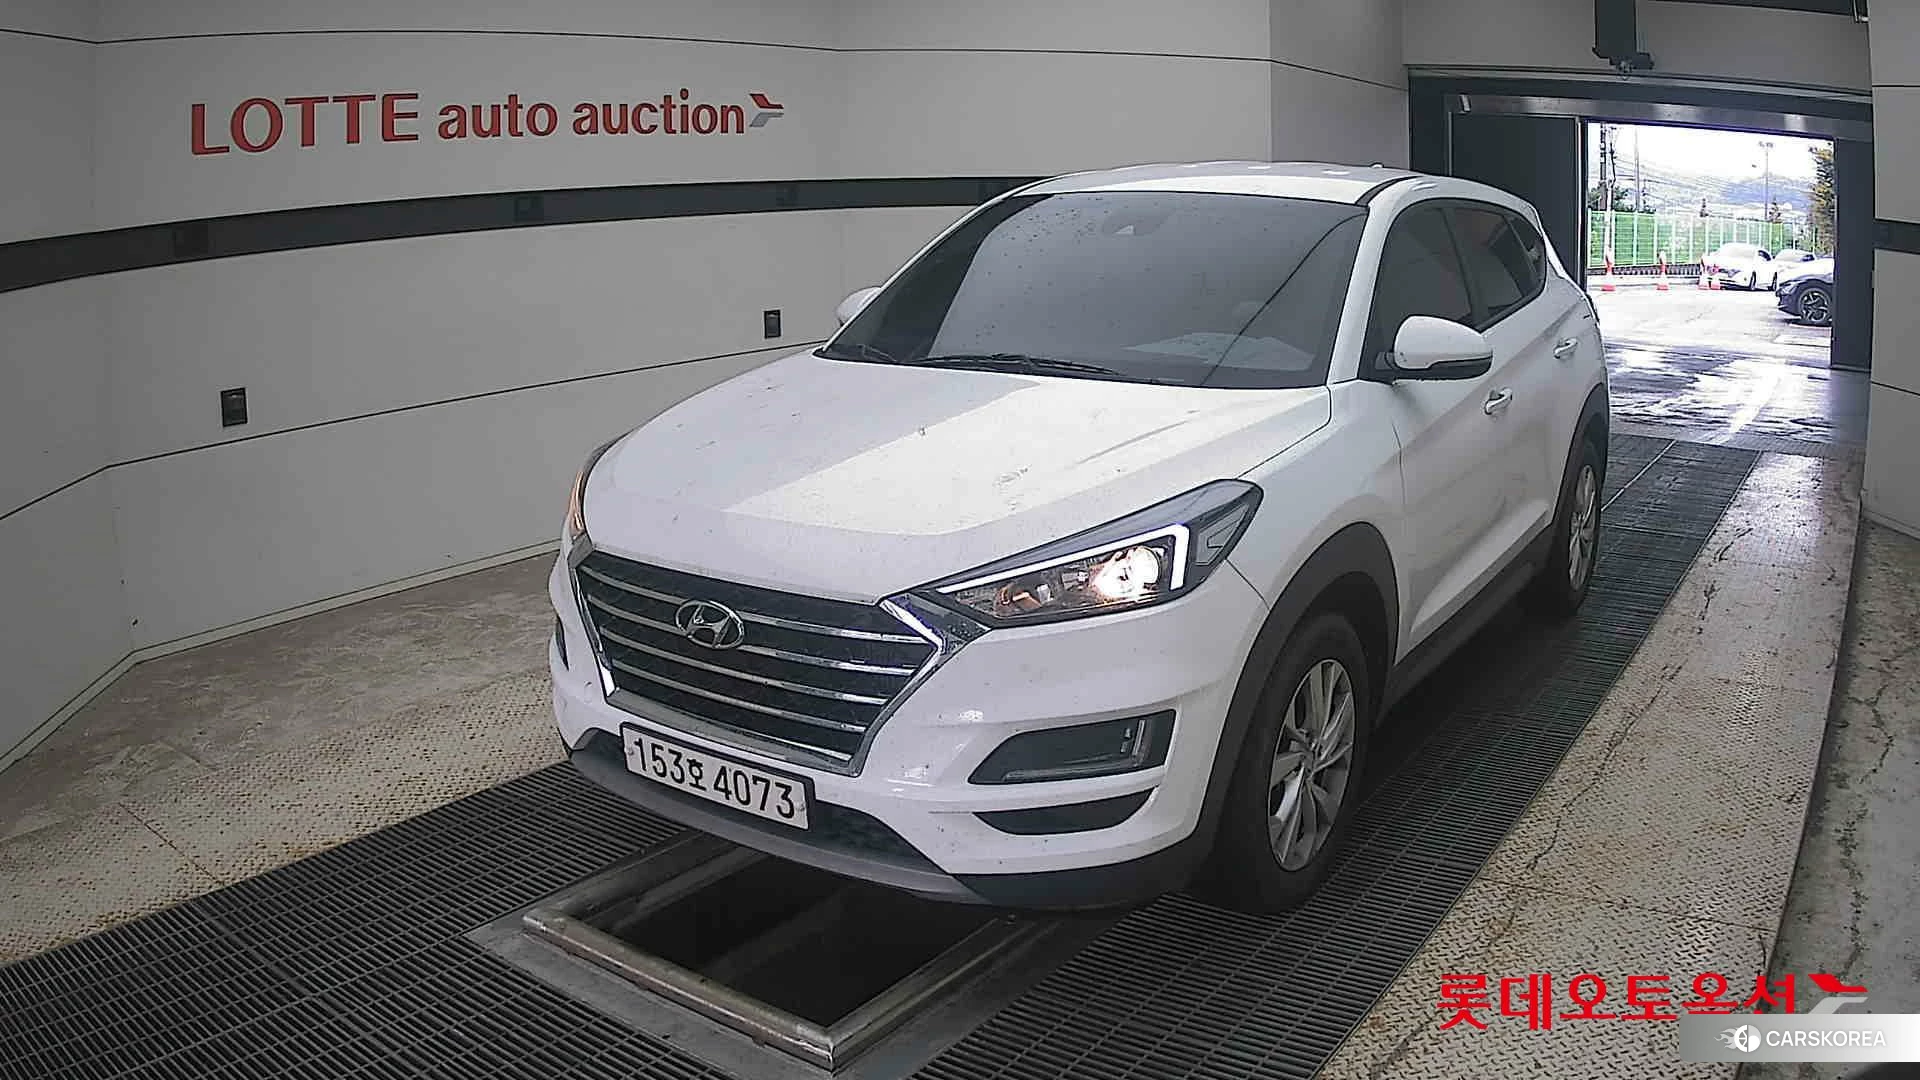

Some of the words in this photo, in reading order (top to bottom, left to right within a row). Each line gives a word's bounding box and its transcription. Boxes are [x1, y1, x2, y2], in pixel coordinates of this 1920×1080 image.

[191, 93, 419, 156] LOTTE
[437, 94, 559, 140] auto
[572, 88, 746, 136] auction
[634, 738, 707, 791] 153호
[713, 765, 795, 819] 4073
